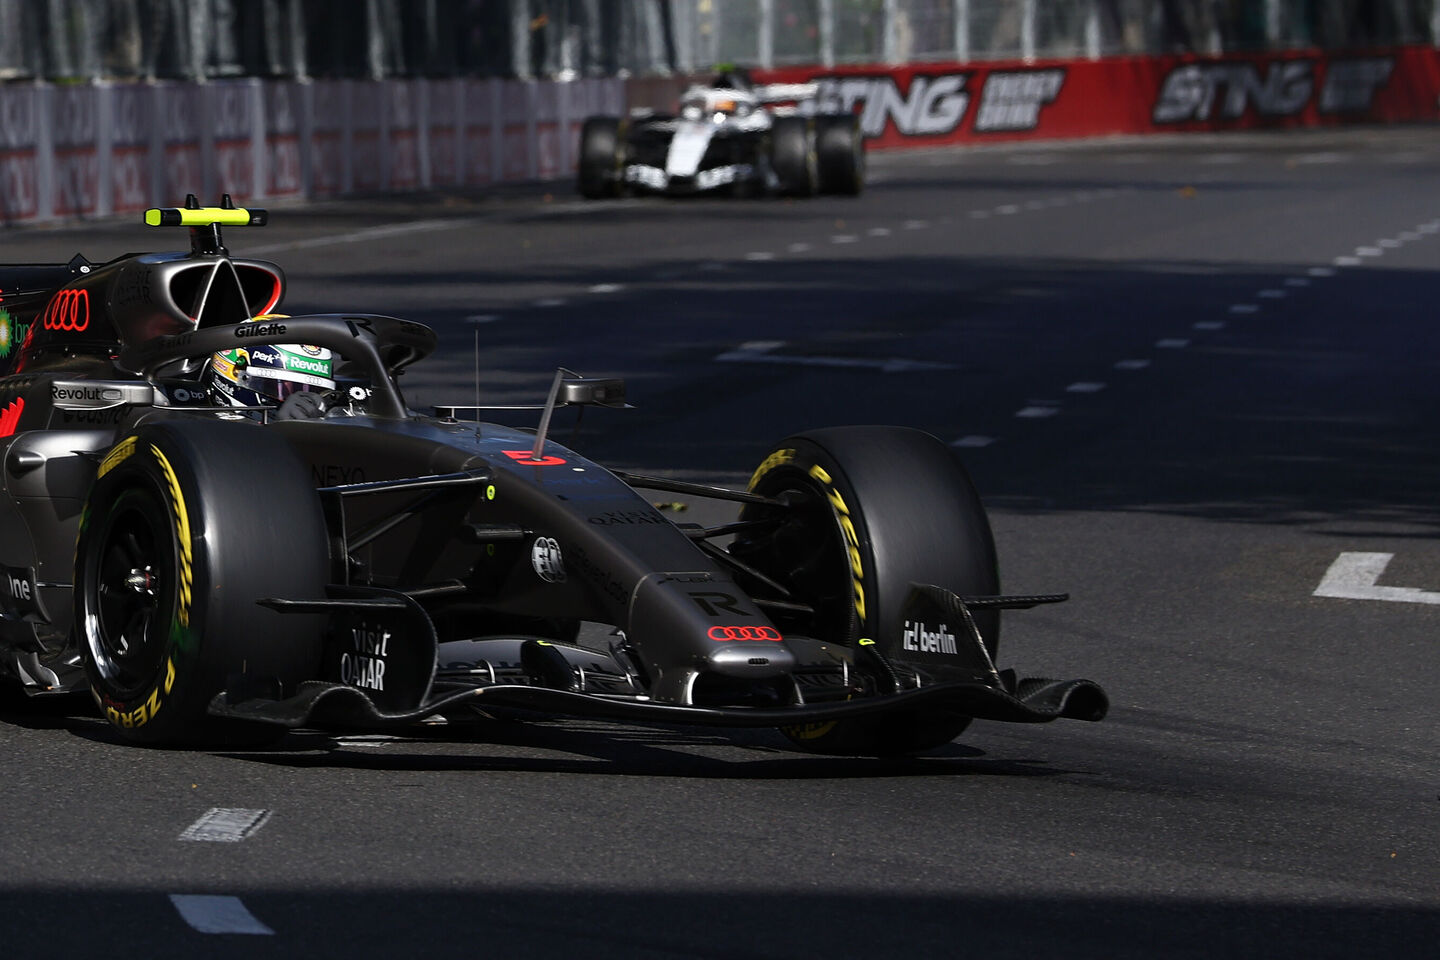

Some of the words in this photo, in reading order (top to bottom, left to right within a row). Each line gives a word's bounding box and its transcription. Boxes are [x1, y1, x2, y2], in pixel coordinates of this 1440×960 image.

[234, 322, 287, 339] Gillette
[290, 356, 329, 375] Revolut
[51, 386, 101, 402] Revolut
[352, 620, 392, 658] visit
[919, 622, 958, 656] berlin
[340, 651, 386, 692] QATAR
